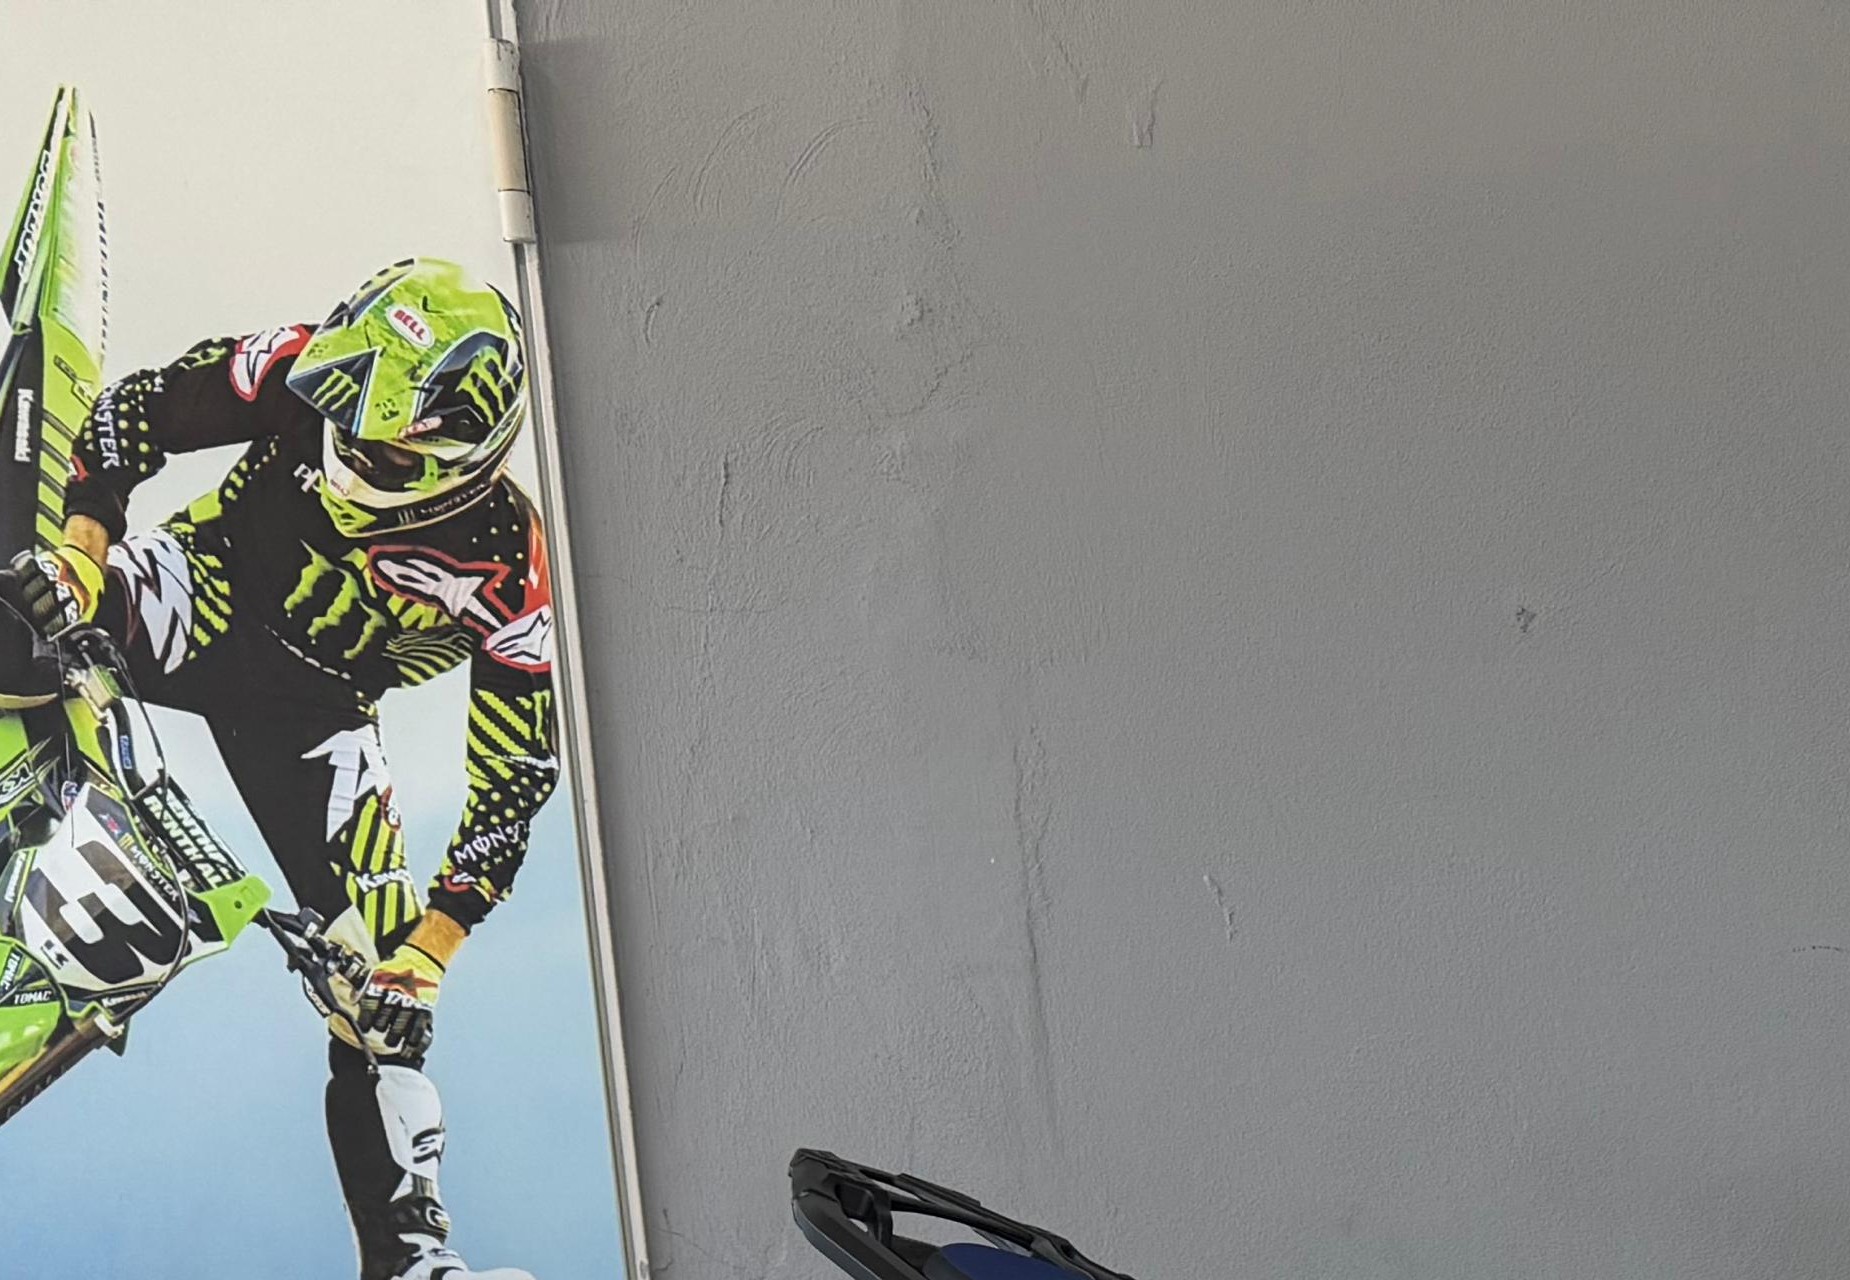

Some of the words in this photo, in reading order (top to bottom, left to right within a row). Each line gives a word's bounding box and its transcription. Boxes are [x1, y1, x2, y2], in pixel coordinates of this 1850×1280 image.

[393, 309, 426, 342] BELL
[24, 840, 192, 985] 3
[14, 990, 52, 1005] TOMAC
